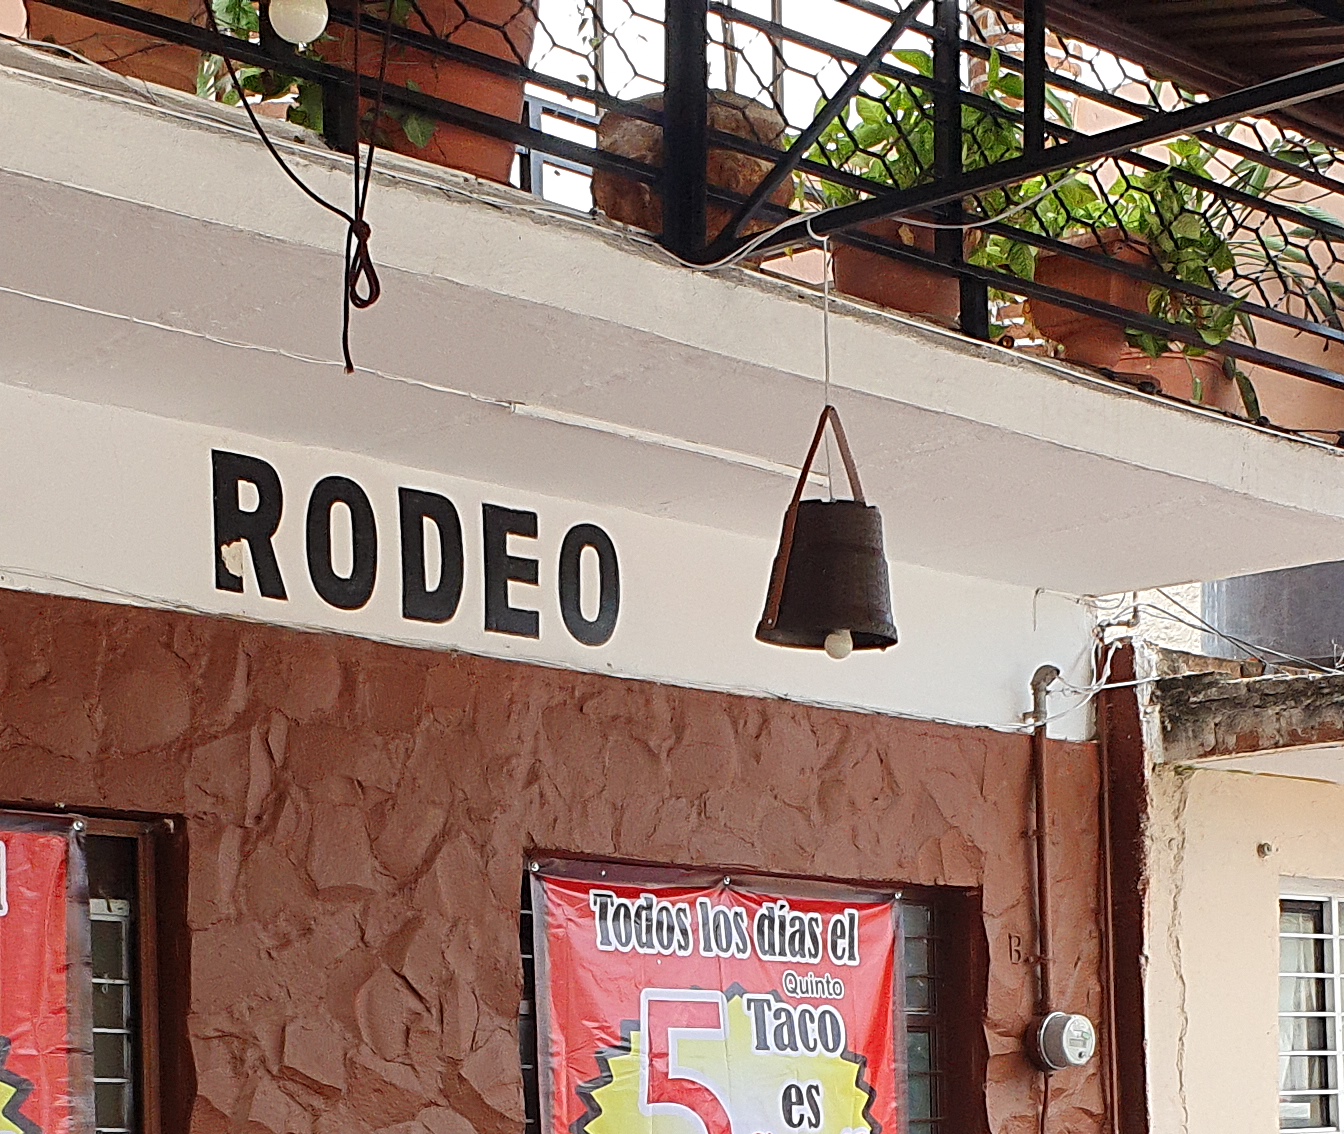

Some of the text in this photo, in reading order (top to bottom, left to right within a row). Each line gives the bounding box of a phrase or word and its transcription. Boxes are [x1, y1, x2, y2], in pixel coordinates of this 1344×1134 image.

[211, 448, 621, 648] RODEO
[590, 891, 860, 966] Todos los días el
[783, 971, 844, 999] Quinto
[742, 993, 846, 1055] Taco
[780, 1082, 822, 1130] es
